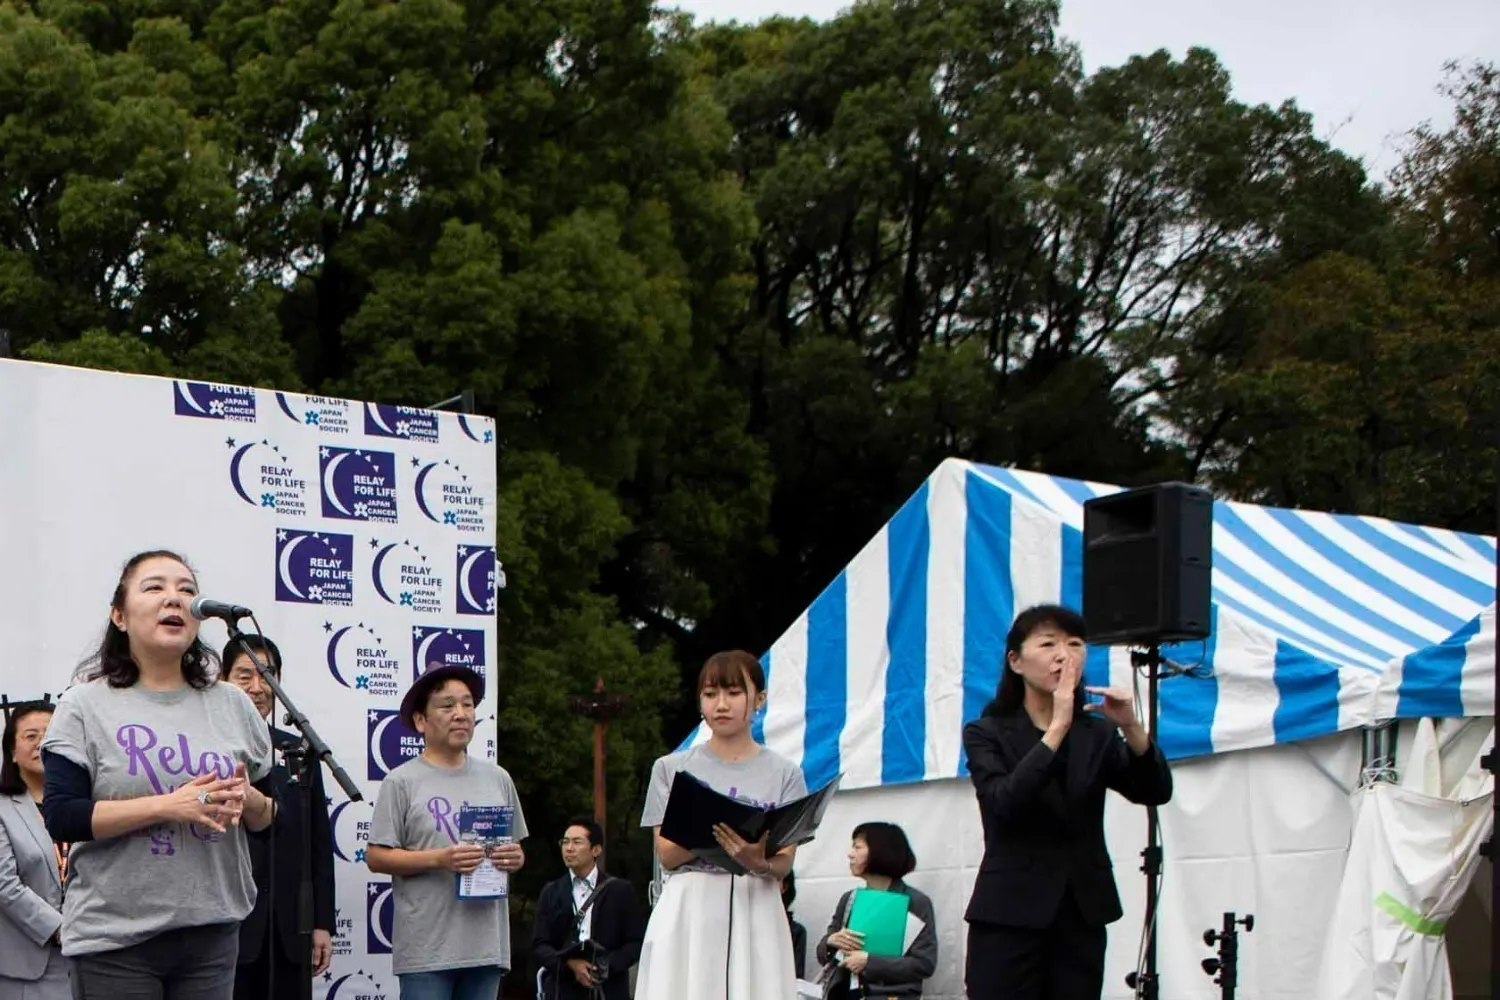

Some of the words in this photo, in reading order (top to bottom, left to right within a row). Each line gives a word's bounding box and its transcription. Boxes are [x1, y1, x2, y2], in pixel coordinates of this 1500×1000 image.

[209, 384, 231, 393] FOR
[234, 386, 255, 396] LIFE
[224, 398, 249, 406] JAPAN
[305, 396, 325, 404] FOR
[328, 398, 349, 407] LIFE
[224, 407, 255, 415] CANCER
[397, 407, 416, 415] FOR
[420, 408, 439, 416] LIFE
[225, 415, 256, 423] SOCIETY
[319, 417, 348, 425] CANCER
[410, 419, 432, 427] JAPAN
[409, 427, 437, 435] CANCER
[261, 465, 292, 477] RELAY
[261, 477, 281, 486] FOR
[285, 479, 305, 489] LIFE
[354, 475, 384, 486] RELAY
[354, 486, 374, 495] FOR
[378, 487, 396, 497] LIFE
[443, 485, 472, 495] RELAY
[275, 491, 299, 499] JAPAN
[443, 495, 462, 504] FOR
[466, 496, 484, 506] LIFE
[367, 508, 396, 516] CANCER
[310, 558, 341, 568] RELAY
[310, 569, 330, 578] FOR
[332, 570, 352, 580] LIFE
[401, 565, 431, 575] RELAY
[401, 575, 420, 585] FOR
[423, 577, 442, 586] LIFE
[322, 590, 351, 599] CANCER
[413, 597, 440, 605] CANCER
[413, 605, 441, 613] SOCIETY
[357, 648, 387, 658] RELAY
[445, 654, 475, 663] RELAY
[357, 659, 376, 668] FOR
[379, 660, 398, 669] LIFE
[369, 680, 397, 688] CANCER
[401, 736, 424, 745] RELA
[401, 747, 419, 756] FOR
[357, 832, 369, 840] FO
[336, 919, 352, 928] IFE
